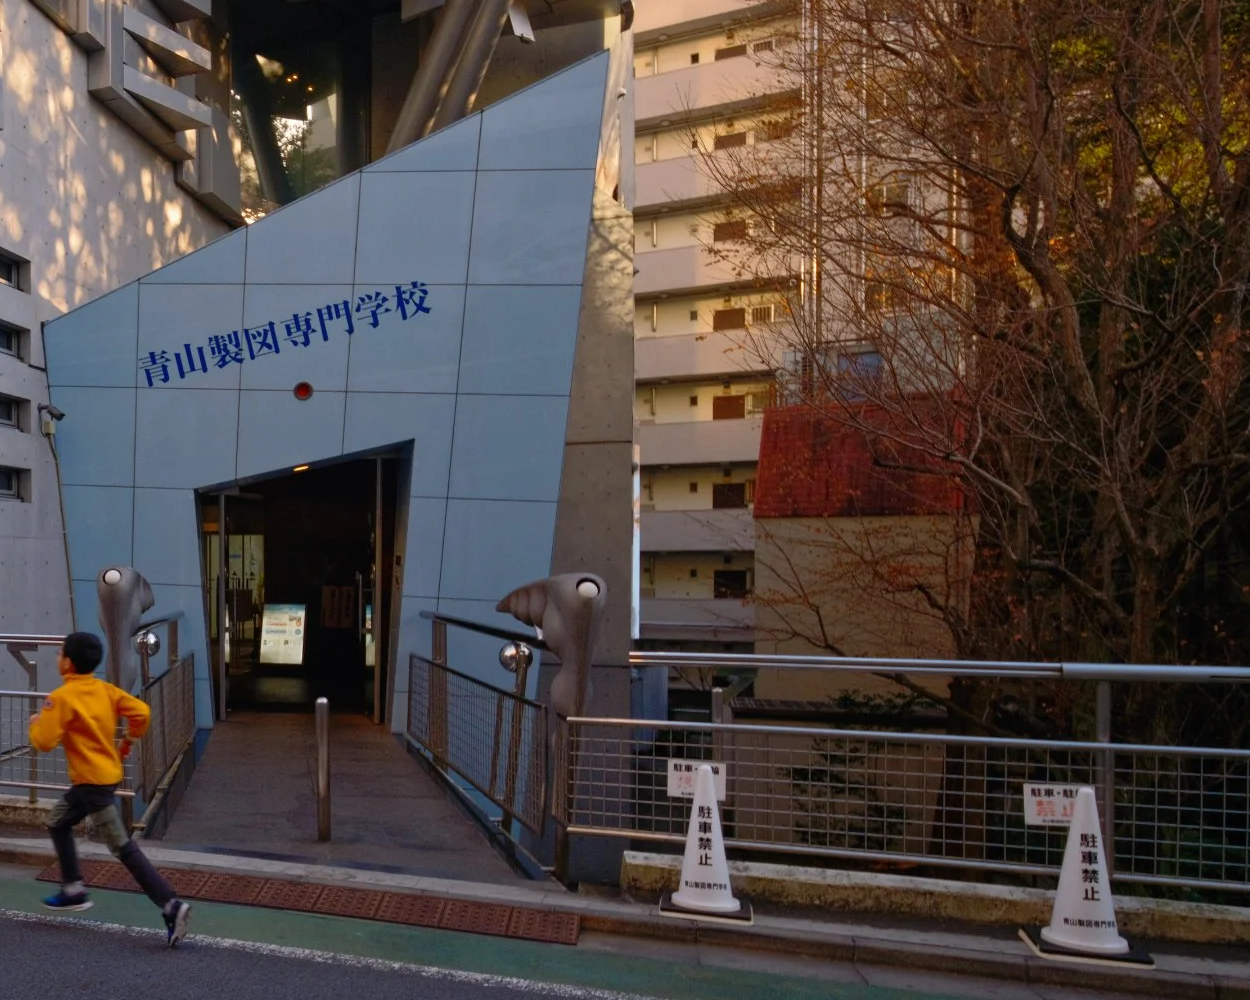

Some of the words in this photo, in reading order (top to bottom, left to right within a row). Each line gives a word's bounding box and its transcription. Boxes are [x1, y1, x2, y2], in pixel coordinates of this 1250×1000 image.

[138, 281, 432, 387] 青山製図専門学校
[673, 763, 720, 775] 駐車・輪
[1031, 787, 1079, 798] 駐車・駐
[698, 805, 713, 867] 駐車禁止
[1081, 834, 1099, 900] 駐車禁止
